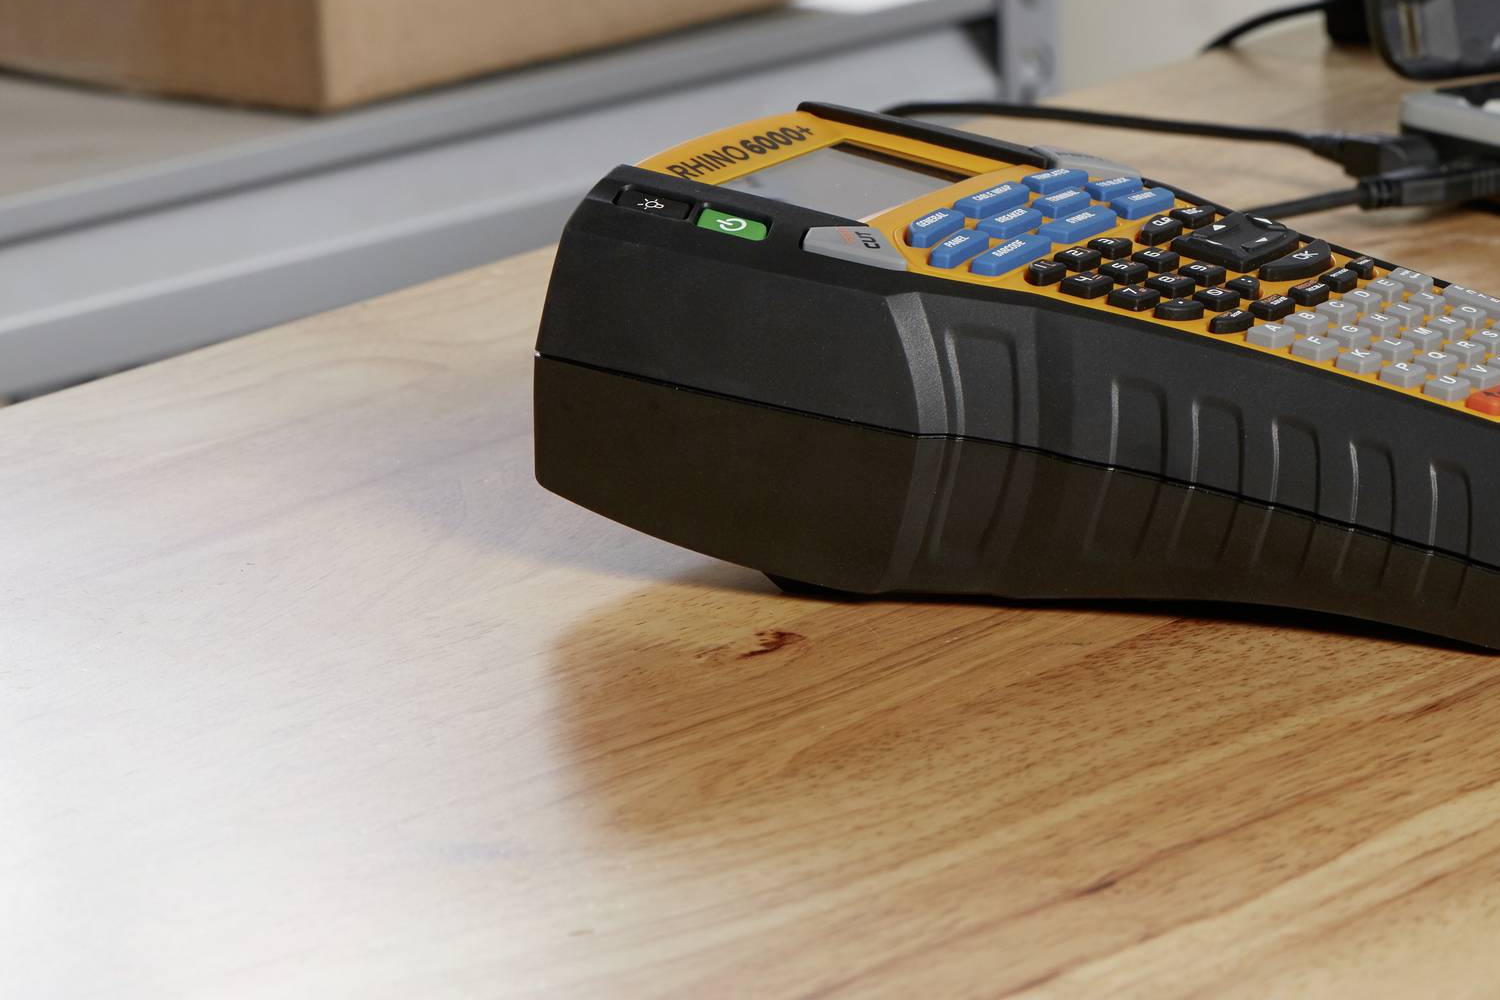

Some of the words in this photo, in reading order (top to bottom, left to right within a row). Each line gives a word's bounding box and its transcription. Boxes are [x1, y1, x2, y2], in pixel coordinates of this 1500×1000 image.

[916, 211, 949, 227] GENERAL
[1152, 217, 1173, 226] CLR
[855, 231, 880, 249] CUT
[944, 235, 970, 248] PANEL
[992, 239, 1026, 257] BARCODE
[1292, 250, 1319, 260] OK
[1422, 292, 1434, 300] J
[1370, 313, 1388, 321] H
[1438, 316, 1456, 324] N
[1265, 324, 1282, 332] A
[1413, 327, 1432, 335] M
[1482, 330, 1498, 338] S
[1307, 336, 1321, 344] F
[1456, 341, 1476, 349] R
[1351, 349, 1370, 358] K
[1428, 351, 1447, 359] Q
[1395, 363, 1409, 371] P
[1471, 365, 1488, 373] V
[1440, 375, 1456, 384] U
